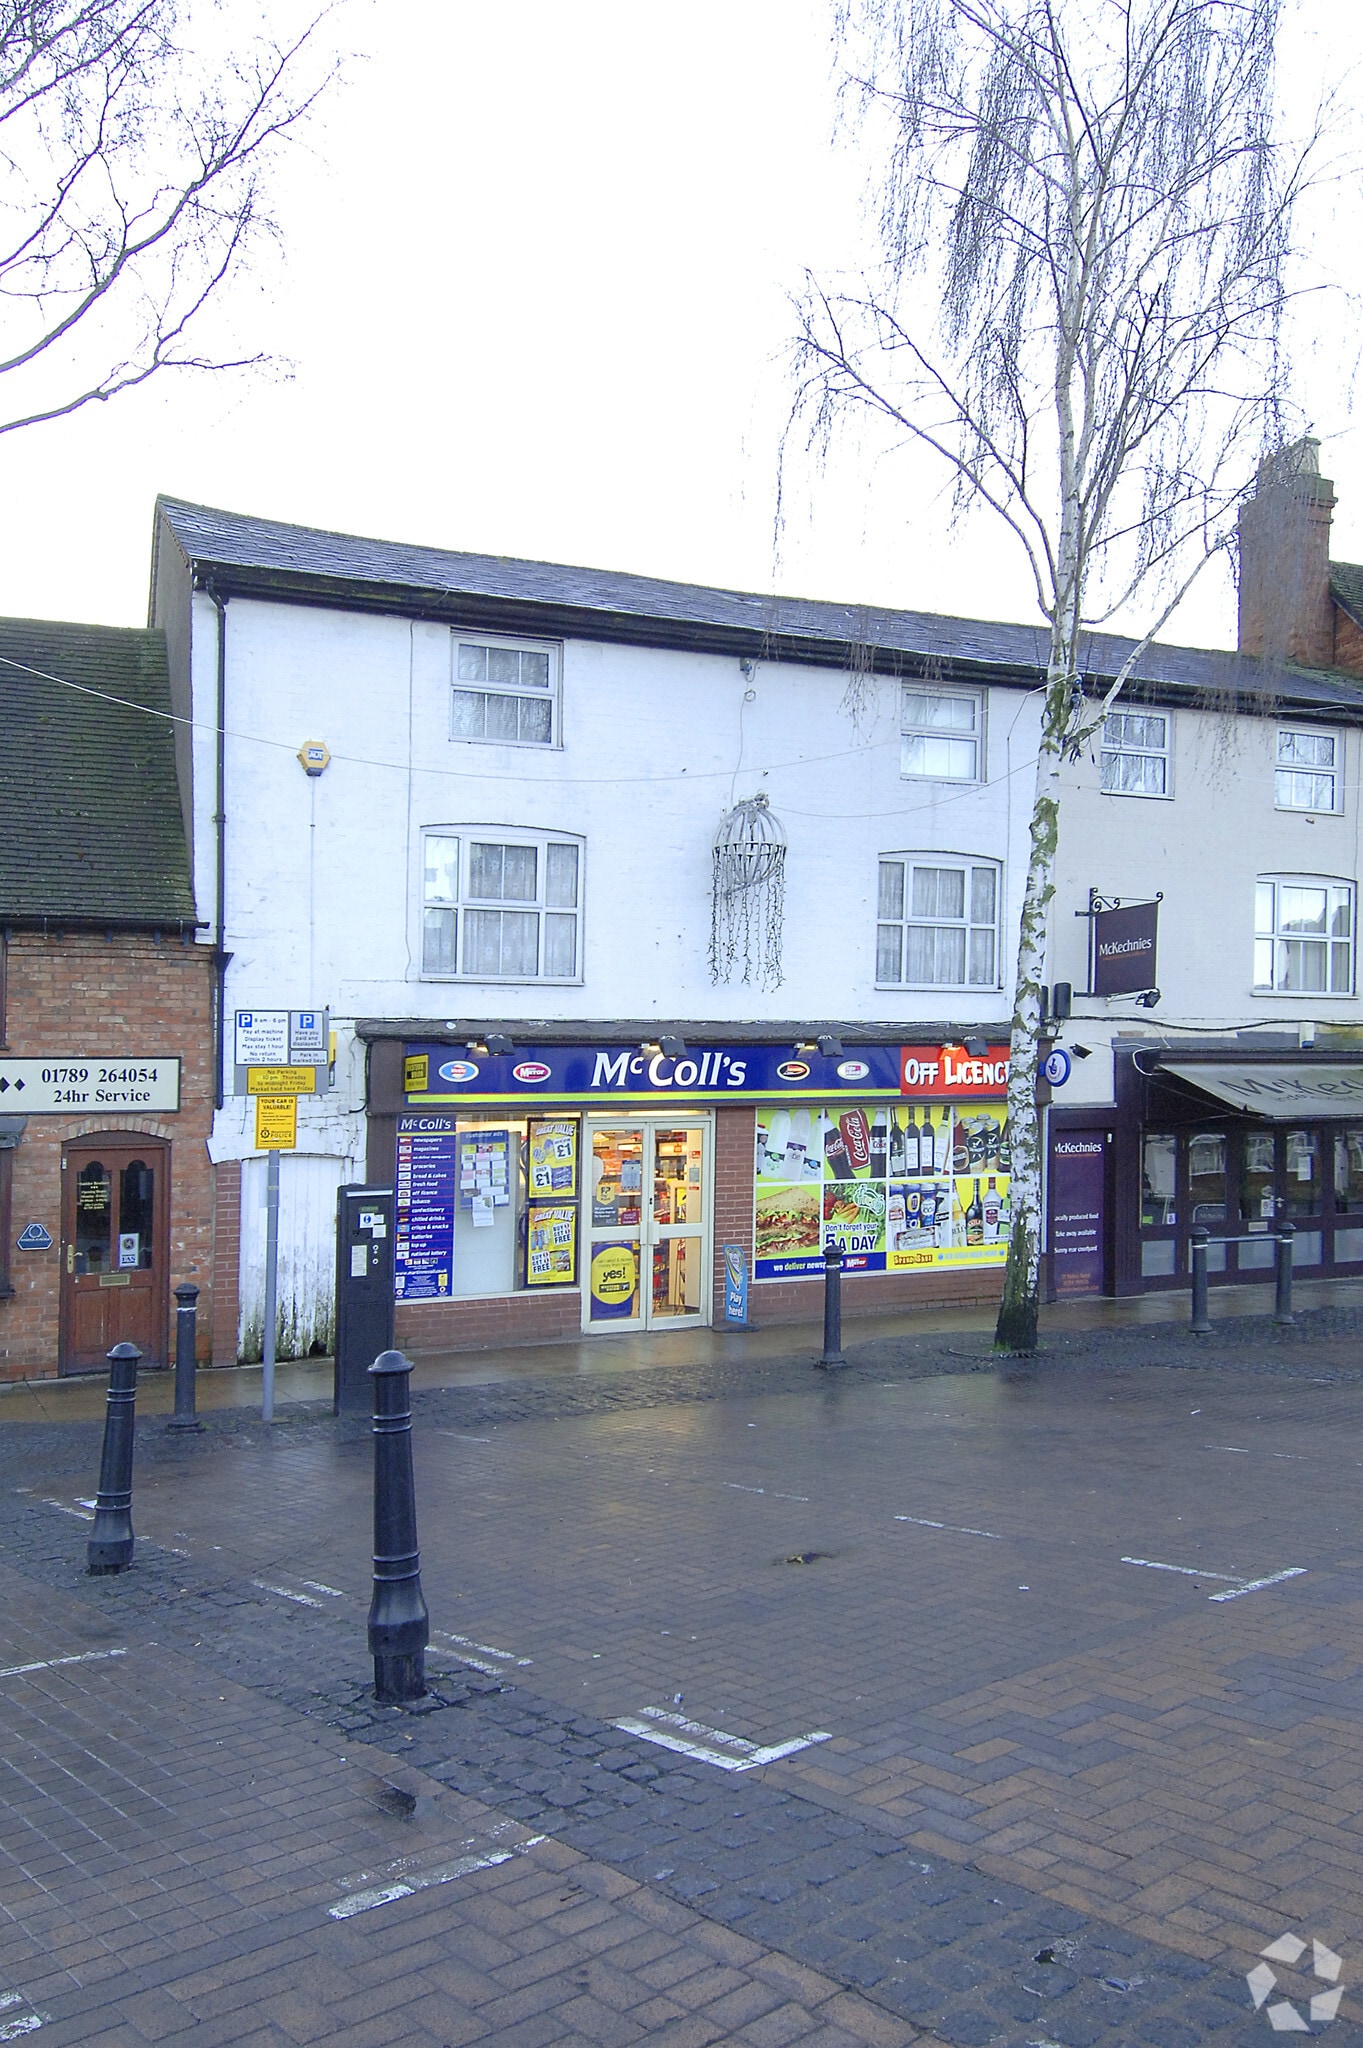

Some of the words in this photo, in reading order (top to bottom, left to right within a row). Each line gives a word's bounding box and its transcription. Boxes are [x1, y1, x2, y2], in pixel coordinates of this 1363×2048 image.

[1099, 938, 1152, 956] McKechnies
[241, 1015, 250, 1026] P
[303, 1016, 312, 1027] P
[42, 1069, 88, 1083] 01789
[98, 1069, 158, 1082] 264054
[905, 1058, 939, 1085] OFF
[54, 1090, 89, 1102] 24hr
[95, 1089, 150, 1102] Service
[536, 1125, 554, 1136] GREAT
[555, 1124, 575, 1136] VALUE
[557, 1143, 571, 1157] £1
[536, 1172, 550, 1186] £1
[534, 1211, 552, 1221] GREAT
[554, 1210, 574, 1222] VALUE
[843, 1223, 863, 1231] forget
[554, 1234, 571, 1245] FREE
[826, 1234, 836, 1248] 5
[838, 1237, 846, 1251] A
[852, 1236, 875, 1251] DAY
[533, 1263, 550, 1273] FREE
[785, 1262, 805, 1270] deliver
[603, 1267, 626, 1282] yes!
[730, 1292, 742, 1306] Play
[728, 1305, 743, 1317] here!
